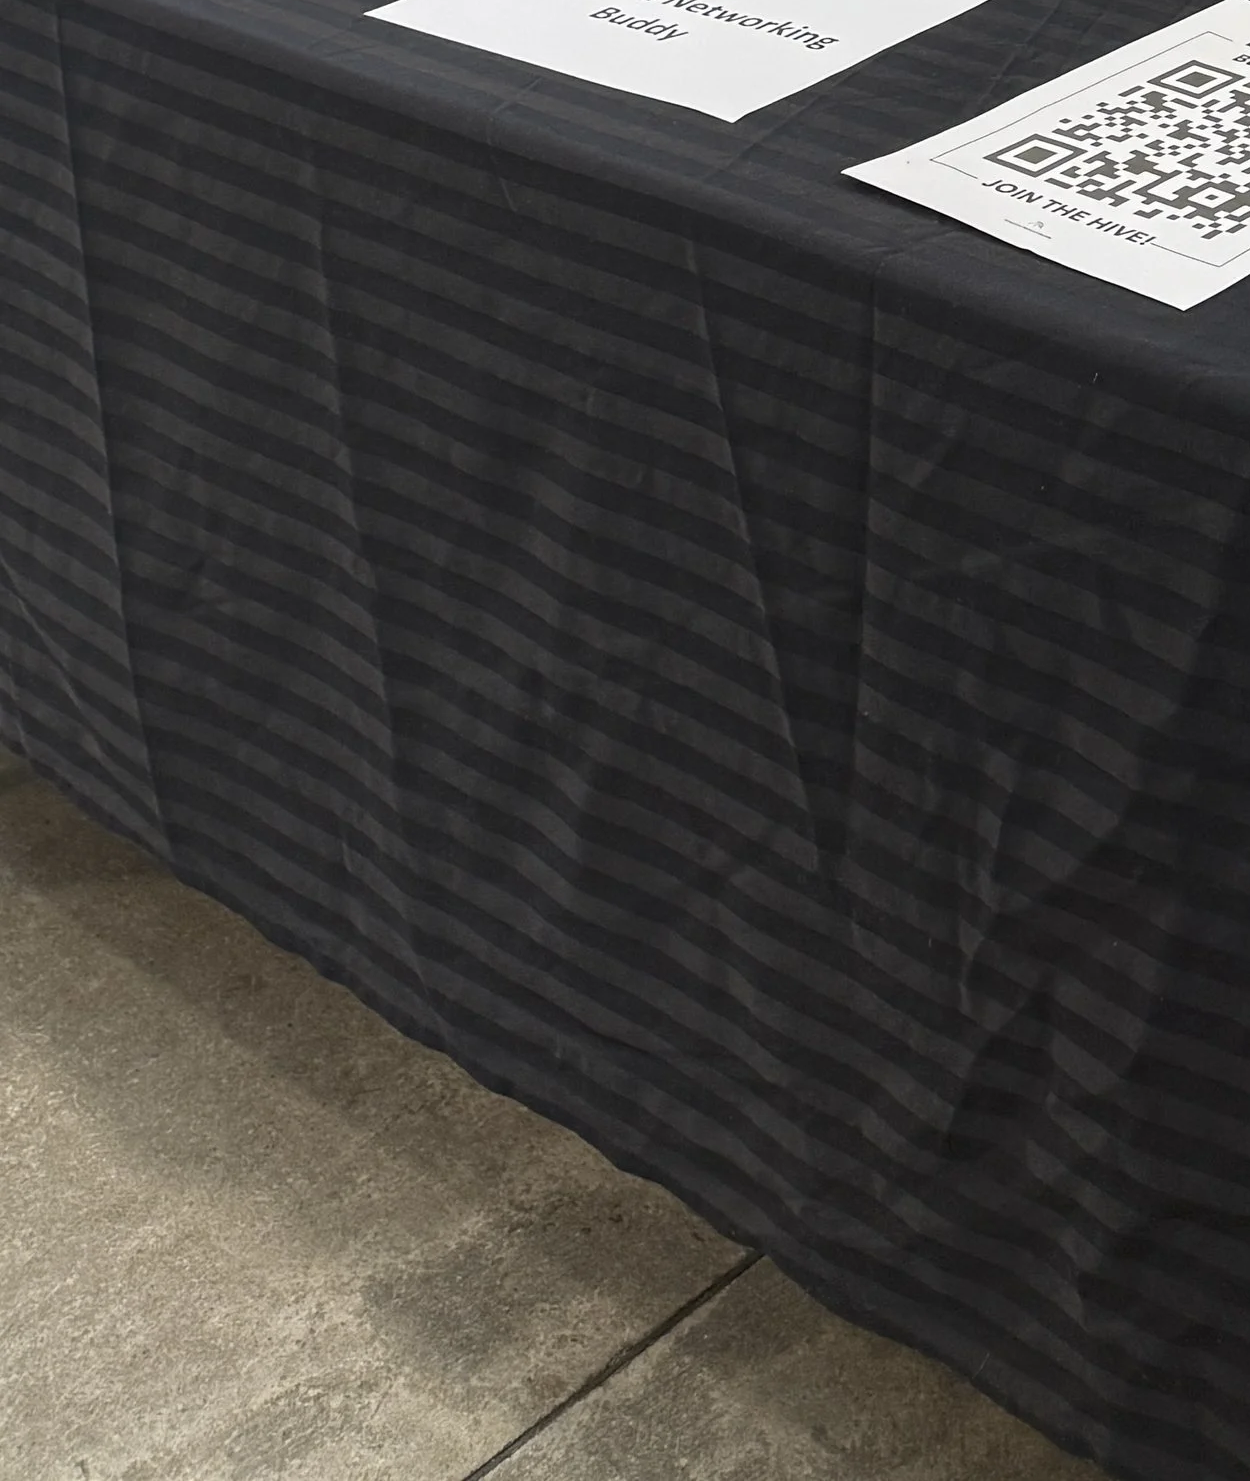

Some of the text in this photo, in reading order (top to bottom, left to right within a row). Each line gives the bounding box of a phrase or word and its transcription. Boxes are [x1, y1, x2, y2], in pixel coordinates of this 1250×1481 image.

[589, 6, 689, 42] Buddy
[982, 179, 1156, 246] JOIN THE HIVE!
